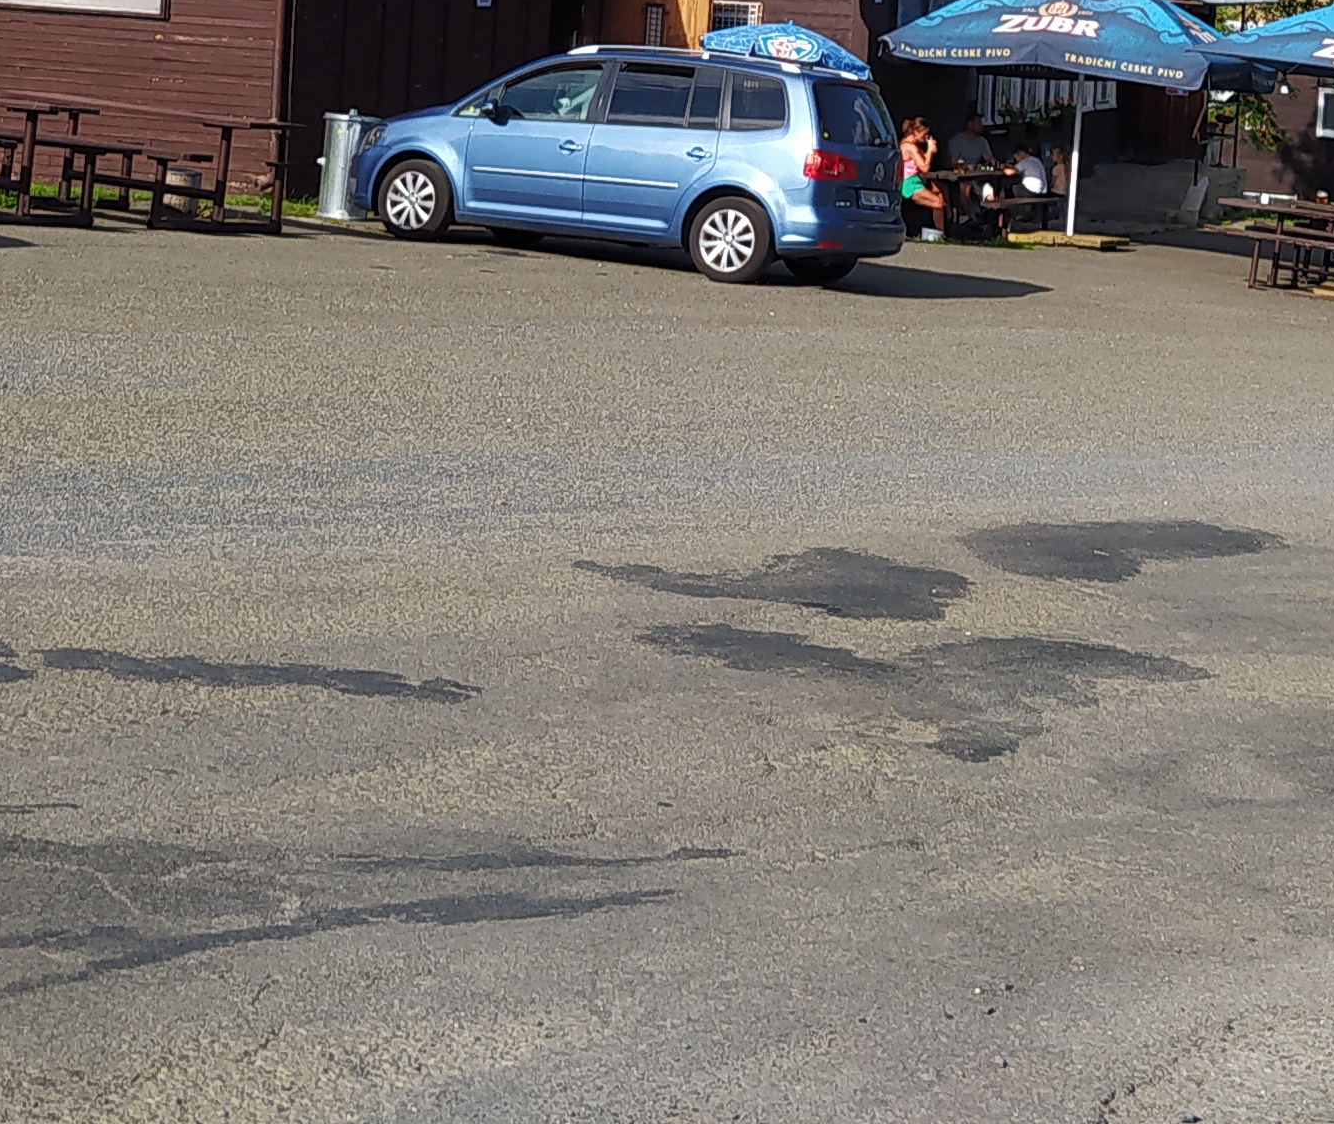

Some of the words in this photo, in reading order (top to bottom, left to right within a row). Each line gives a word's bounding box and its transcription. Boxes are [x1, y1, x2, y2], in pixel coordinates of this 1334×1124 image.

[991, 14, 1101, 38] ZUBR
[986, 47, 1011, 57] PIVO
[1064, 52, 1117, 70] TRADIČNÍ
[1157, 67, 1184, 79] PIVO
